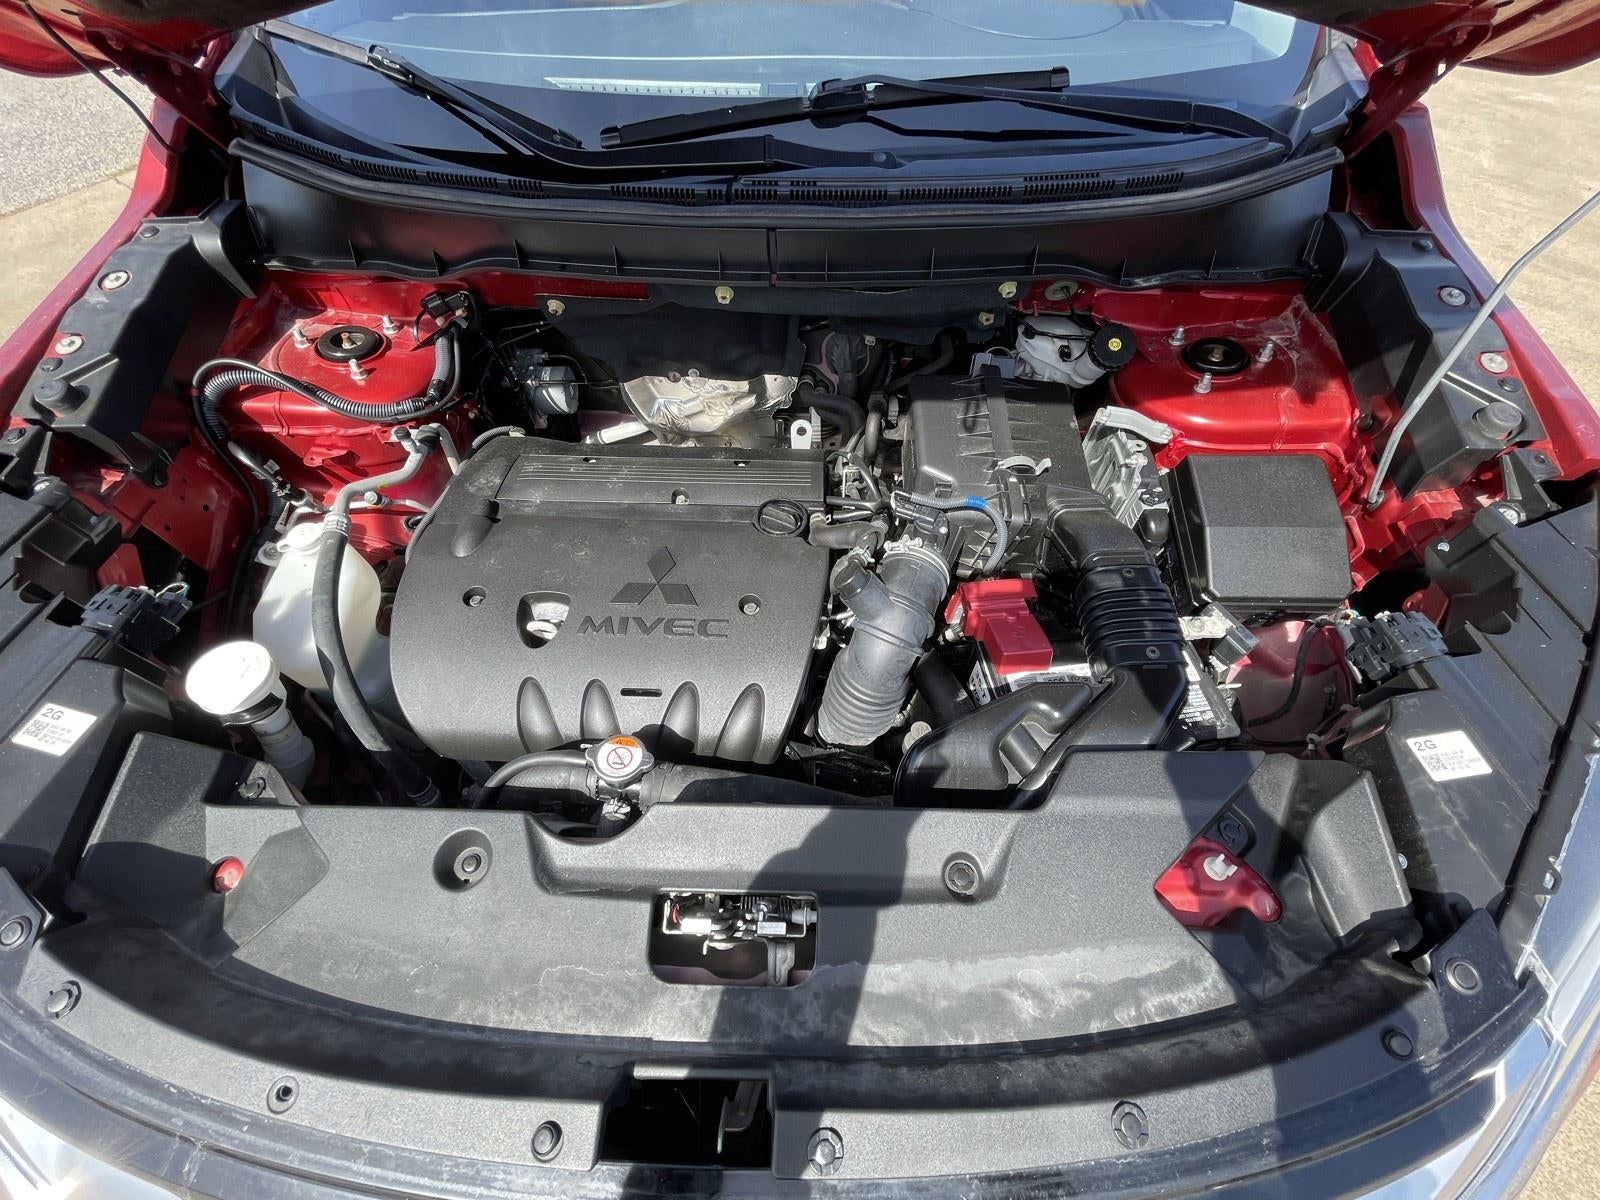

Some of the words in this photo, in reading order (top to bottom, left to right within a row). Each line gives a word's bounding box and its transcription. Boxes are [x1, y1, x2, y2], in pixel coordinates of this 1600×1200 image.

[576, 615, 730, 638] MIVEC
[41, 707, 65, 721] 2G
[1413, 739, 1438, 752] 2G
